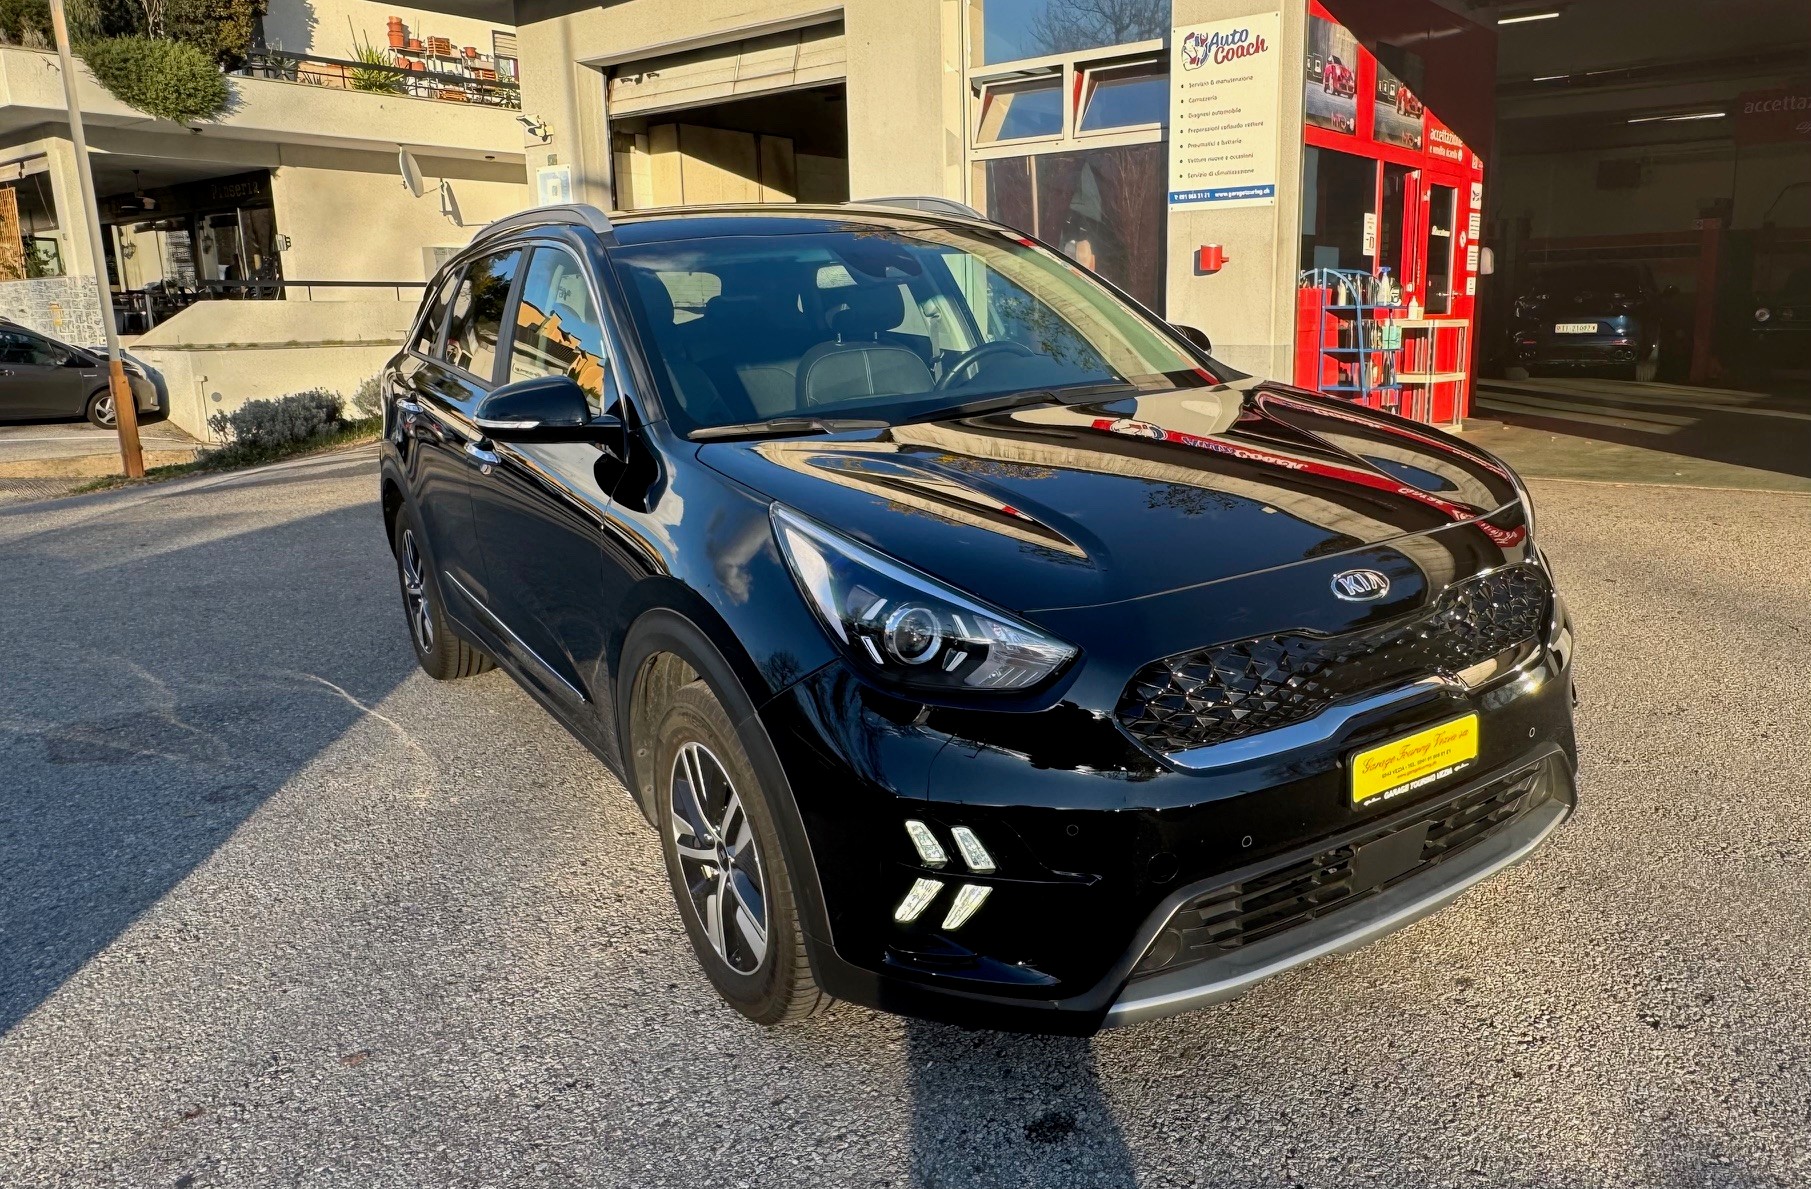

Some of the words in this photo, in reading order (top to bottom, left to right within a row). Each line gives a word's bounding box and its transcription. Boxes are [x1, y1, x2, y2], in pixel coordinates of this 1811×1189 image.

[1208, 28, 1249, 53] Auto
[1214, 34, 1268, 65] Coach
[1744, 96, 1811, 114] accetta
[1338, 572, 1386, 595] KIA
[1362, 755, 1396, 775] Garage
[1397, 744, 1430, 761] Touring
[1384, 783, 1410, 800] GARAGE
[1410, 774, 1436, 790] TOURING
